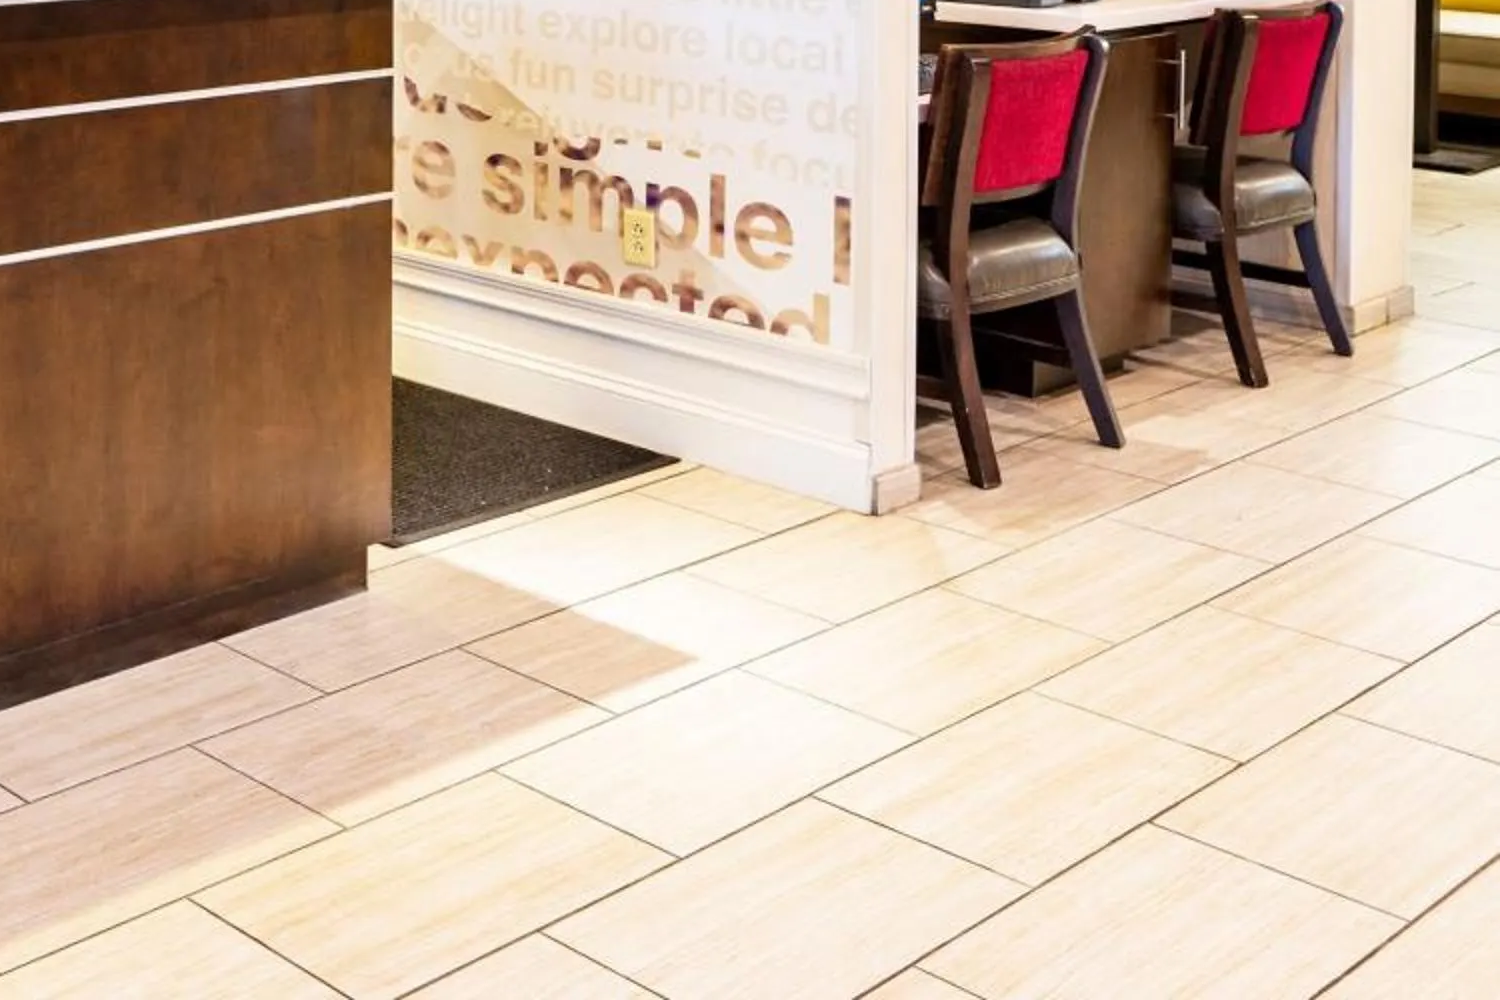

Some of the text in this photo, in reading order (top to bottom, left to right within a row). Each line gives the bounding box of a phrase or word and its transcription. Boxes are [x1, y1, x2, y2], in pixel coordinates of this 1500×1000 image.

[537, 9, 707, 57] explore
[725, 19, 844, 75] local
[510, 47, 577, 92] fun
[592, 68, 788, 127] surprise
[482, 149, 795, 272] simple
